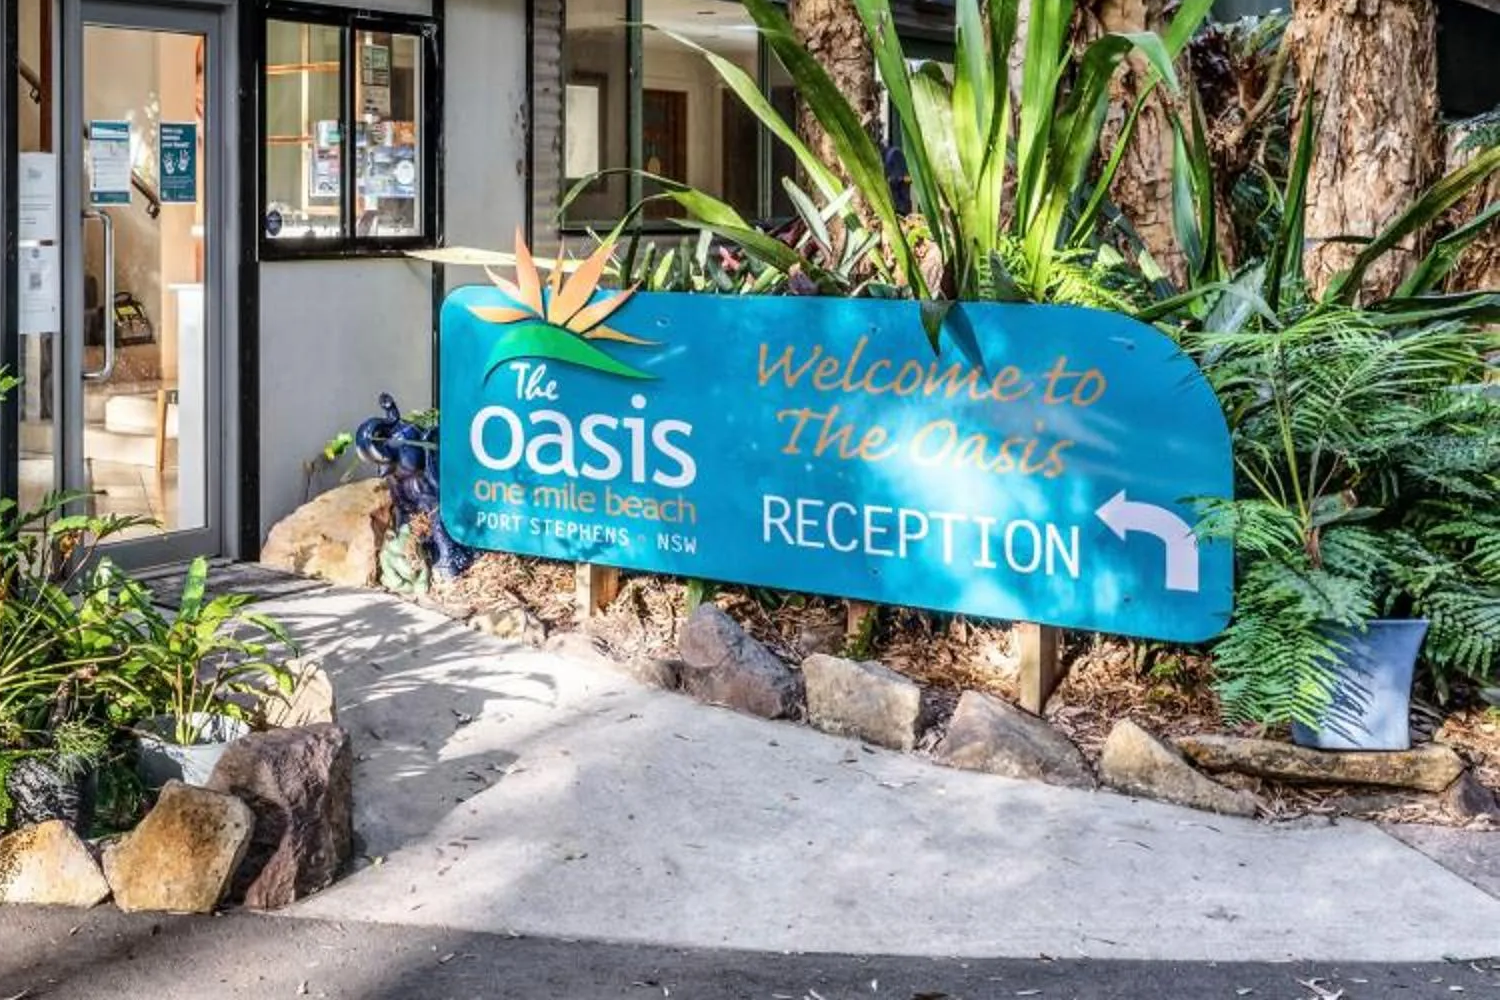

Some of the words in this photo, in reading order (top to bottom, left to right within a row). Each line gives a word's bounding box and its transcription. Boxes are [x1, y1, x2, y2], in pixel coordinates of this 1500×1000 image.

[510, 361, 560, 400] The
[757, 335, 1035, 401] Welcome
[1040, 355, 1108, 407] to
[470, 393, 697, 488] oasis
[776, 405, 900, 461] The
[908, 418, 1076, 479] Oasis
[474, 479, 525, 505] one
[532, 482, 597, 513] mile
[605, 486, 697, 525] beach
[476, 511, 523, 531] PORT
[529, 517, 630, 547] STEPHENS
[657, 532, 697, 555] NSW
[763, 494, 1080, 580] RECEPTION
